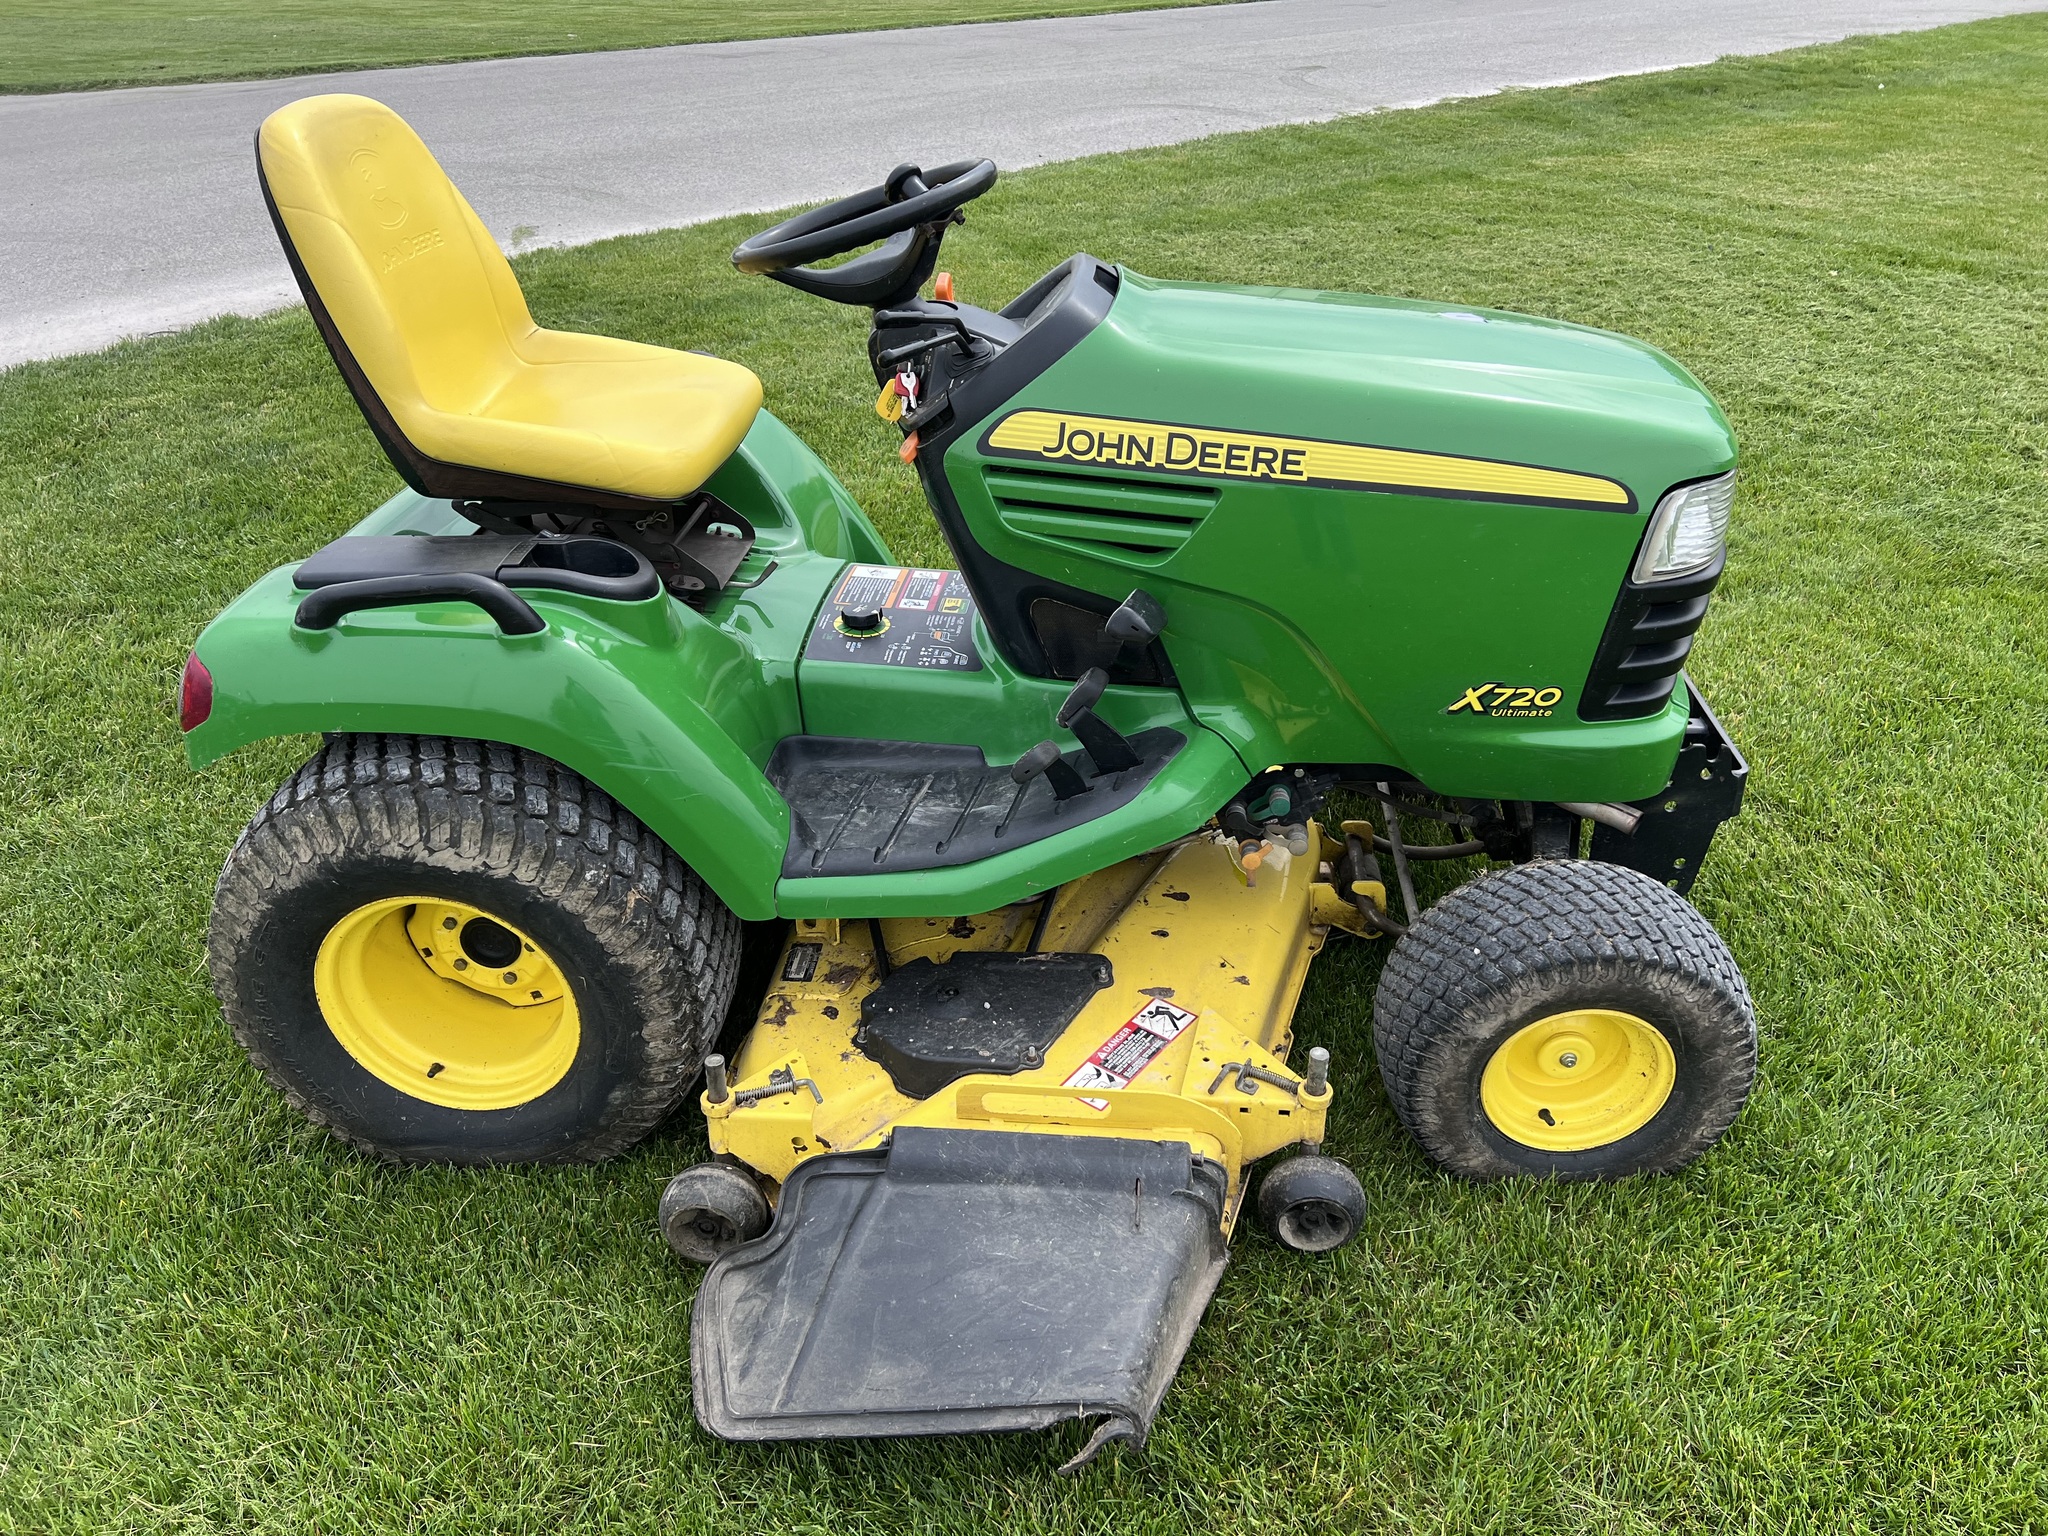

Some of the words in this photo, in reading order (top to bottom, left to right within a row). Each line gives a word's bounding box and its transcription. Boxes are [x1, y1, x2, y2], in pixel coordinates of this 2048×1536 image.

[1041, 421, 1155, 464] JOHN
[1164, 431, 1307, 478] DEERE
[1446, 682, 1564, 713] X720
[1491, 708, 1553, 718] Ultimate
[1102, 1027, 1132, 1053] DANGER
